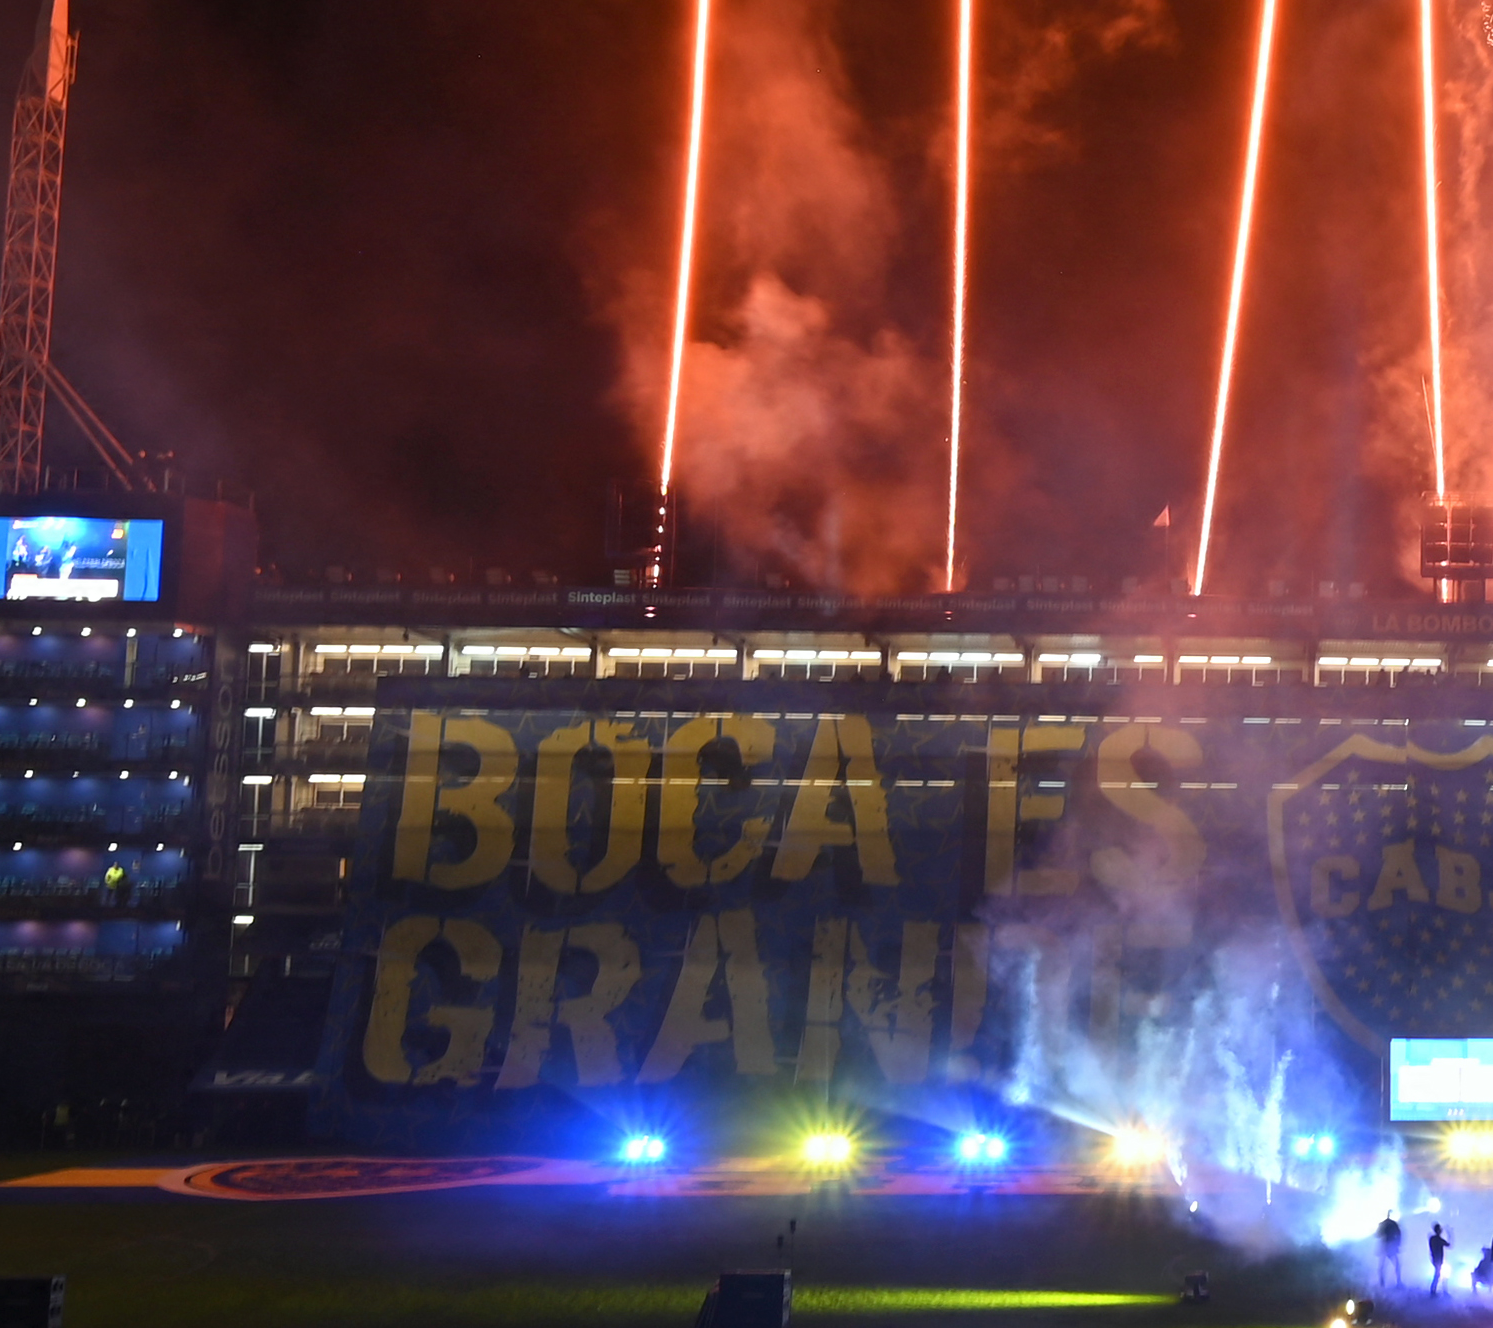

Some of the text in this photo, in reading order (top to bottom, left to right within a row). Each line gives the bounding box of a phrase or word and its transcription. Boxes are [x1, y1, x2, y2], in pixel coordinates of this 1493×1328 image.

[567, 590, 636, 607] Sinteplast
[1372, 614, 1399, 633] LA
[392, 711, 1204, 898] BOCA ES
